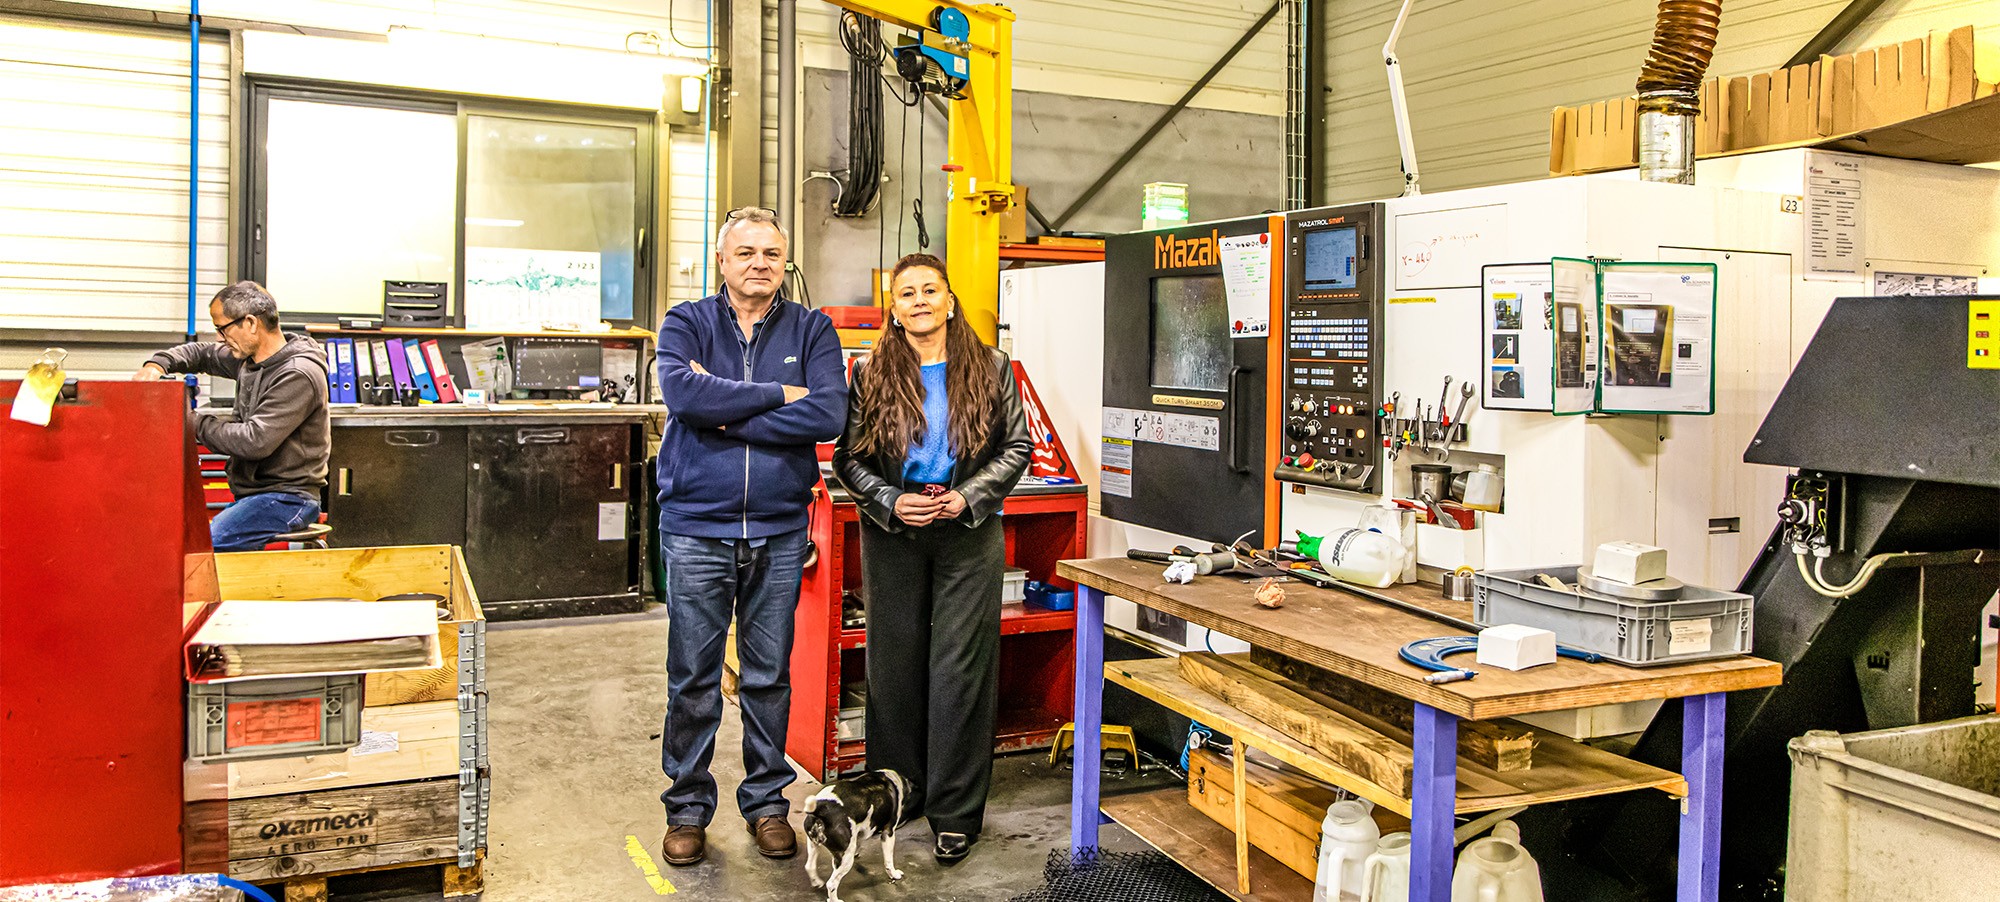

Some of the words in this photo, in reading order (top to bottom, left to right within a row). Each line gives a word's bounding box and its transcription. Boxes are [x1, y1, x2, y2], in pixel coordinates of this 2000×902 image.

[1785, 199, 1798, 212] 23
[1298, 219, 1328, 228] MAZATROL
[1328, 215, 1345, 225] smart
[335, 834, 370, 847] PAU
